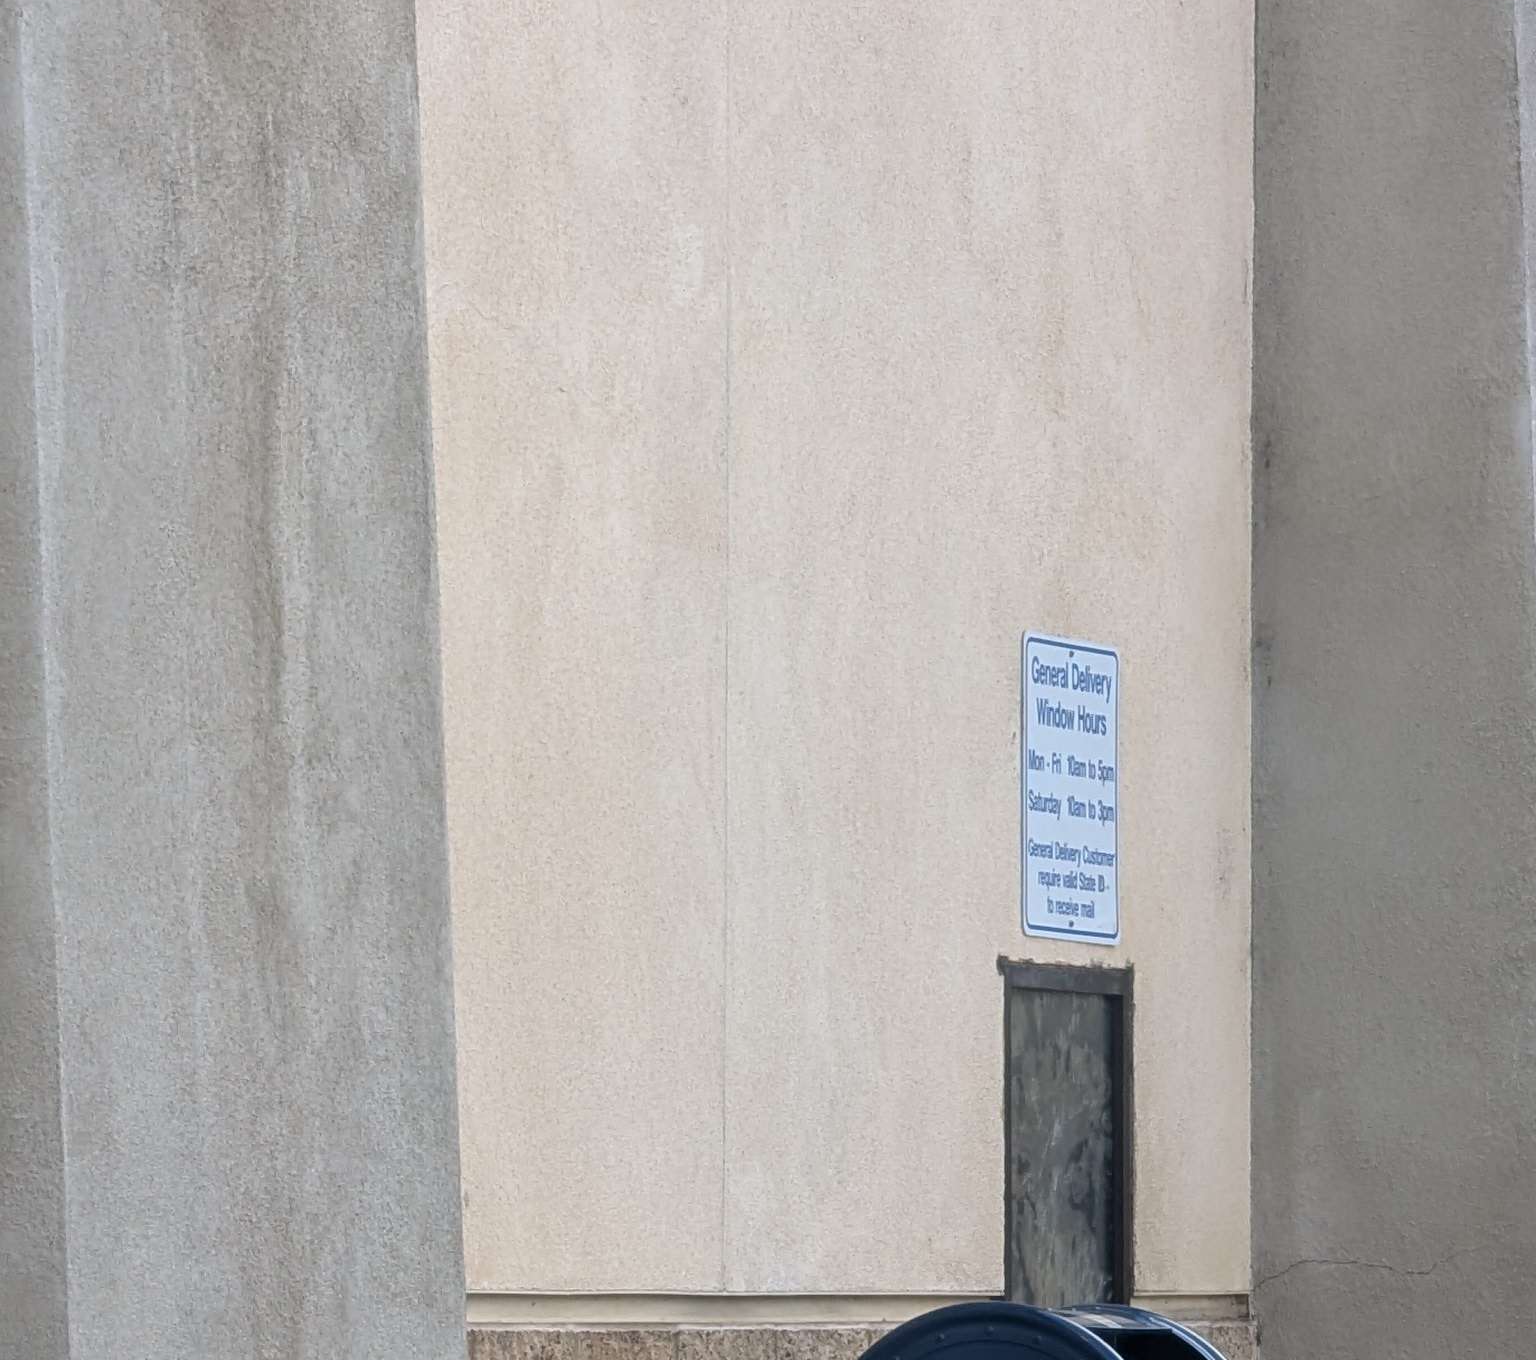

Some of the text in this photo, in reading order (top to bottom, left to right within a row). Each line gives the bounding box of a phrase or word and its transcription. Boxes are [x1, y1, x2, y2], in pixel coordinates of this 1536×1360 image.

[1032, 656, 1112, 703] General Delivery
[1037, 697, 1106, 736] Window Hours
[1029, 749, 1044, 770] Mon
[1052, 752, 1061, 774] Fri
[1067, 755, 1086, 778] 10am
[1088, 759, 1096, 779] to
[1098, 760, 1114, 786] 5pm
[1029, 789, 1114, 826] Saturday 10am to 3pm
[1029, 837, 1053, 859] General
[1055, 841, 1081, 867] Delivery
[1038, 868, 1060, 890] require
[1063, 870, 1077, 889] valid
[1079, 872, 1096, 892] State
[1047, 896, 1094, 918] to receive mail
